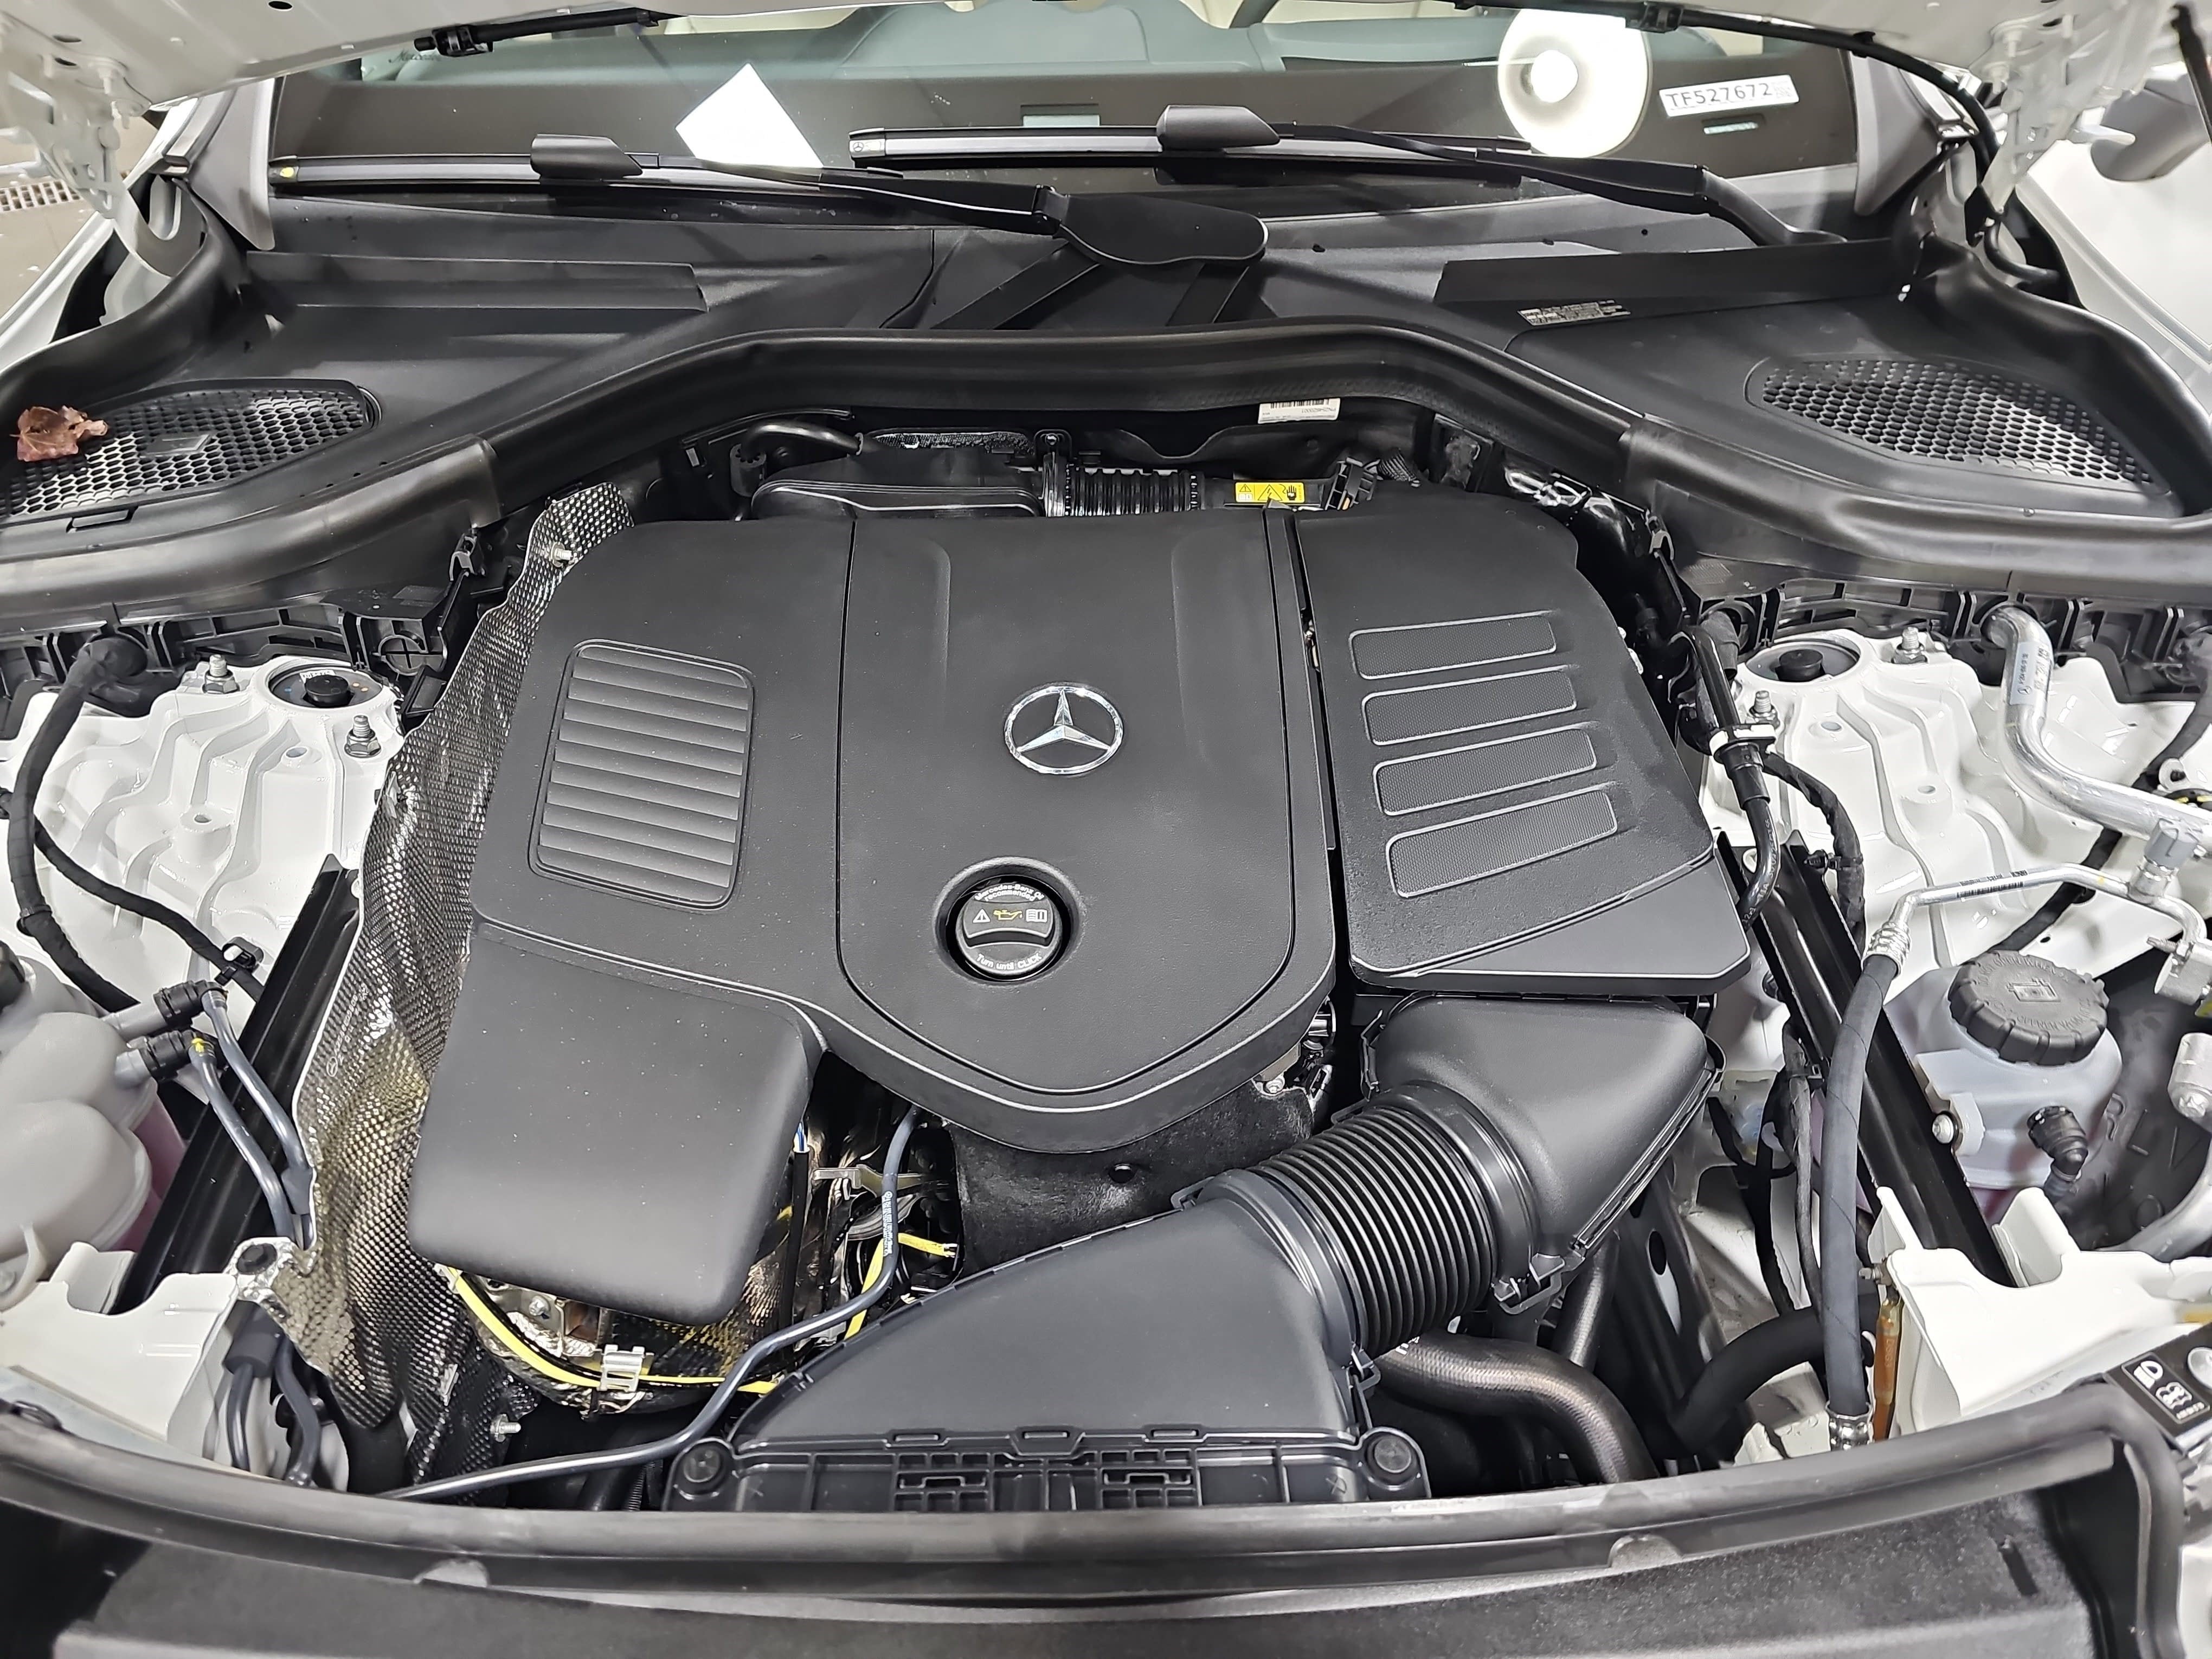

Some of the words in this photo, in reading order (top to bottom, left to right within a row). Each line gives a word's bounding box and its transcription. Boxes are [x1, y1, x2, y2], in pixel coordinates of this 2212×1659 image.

[1666, 83, 1772, 107] TF527672
[974, 884, 1034, 901] Mercedes-Benz
[1034, 891, 1045, 900] Oil
[984, 890, 1035, 901] recommended
[976, 953, 994, 968] Turn
[996, 962, 1014, 970] until
[1017, 953, 1042, 968] CLICK
